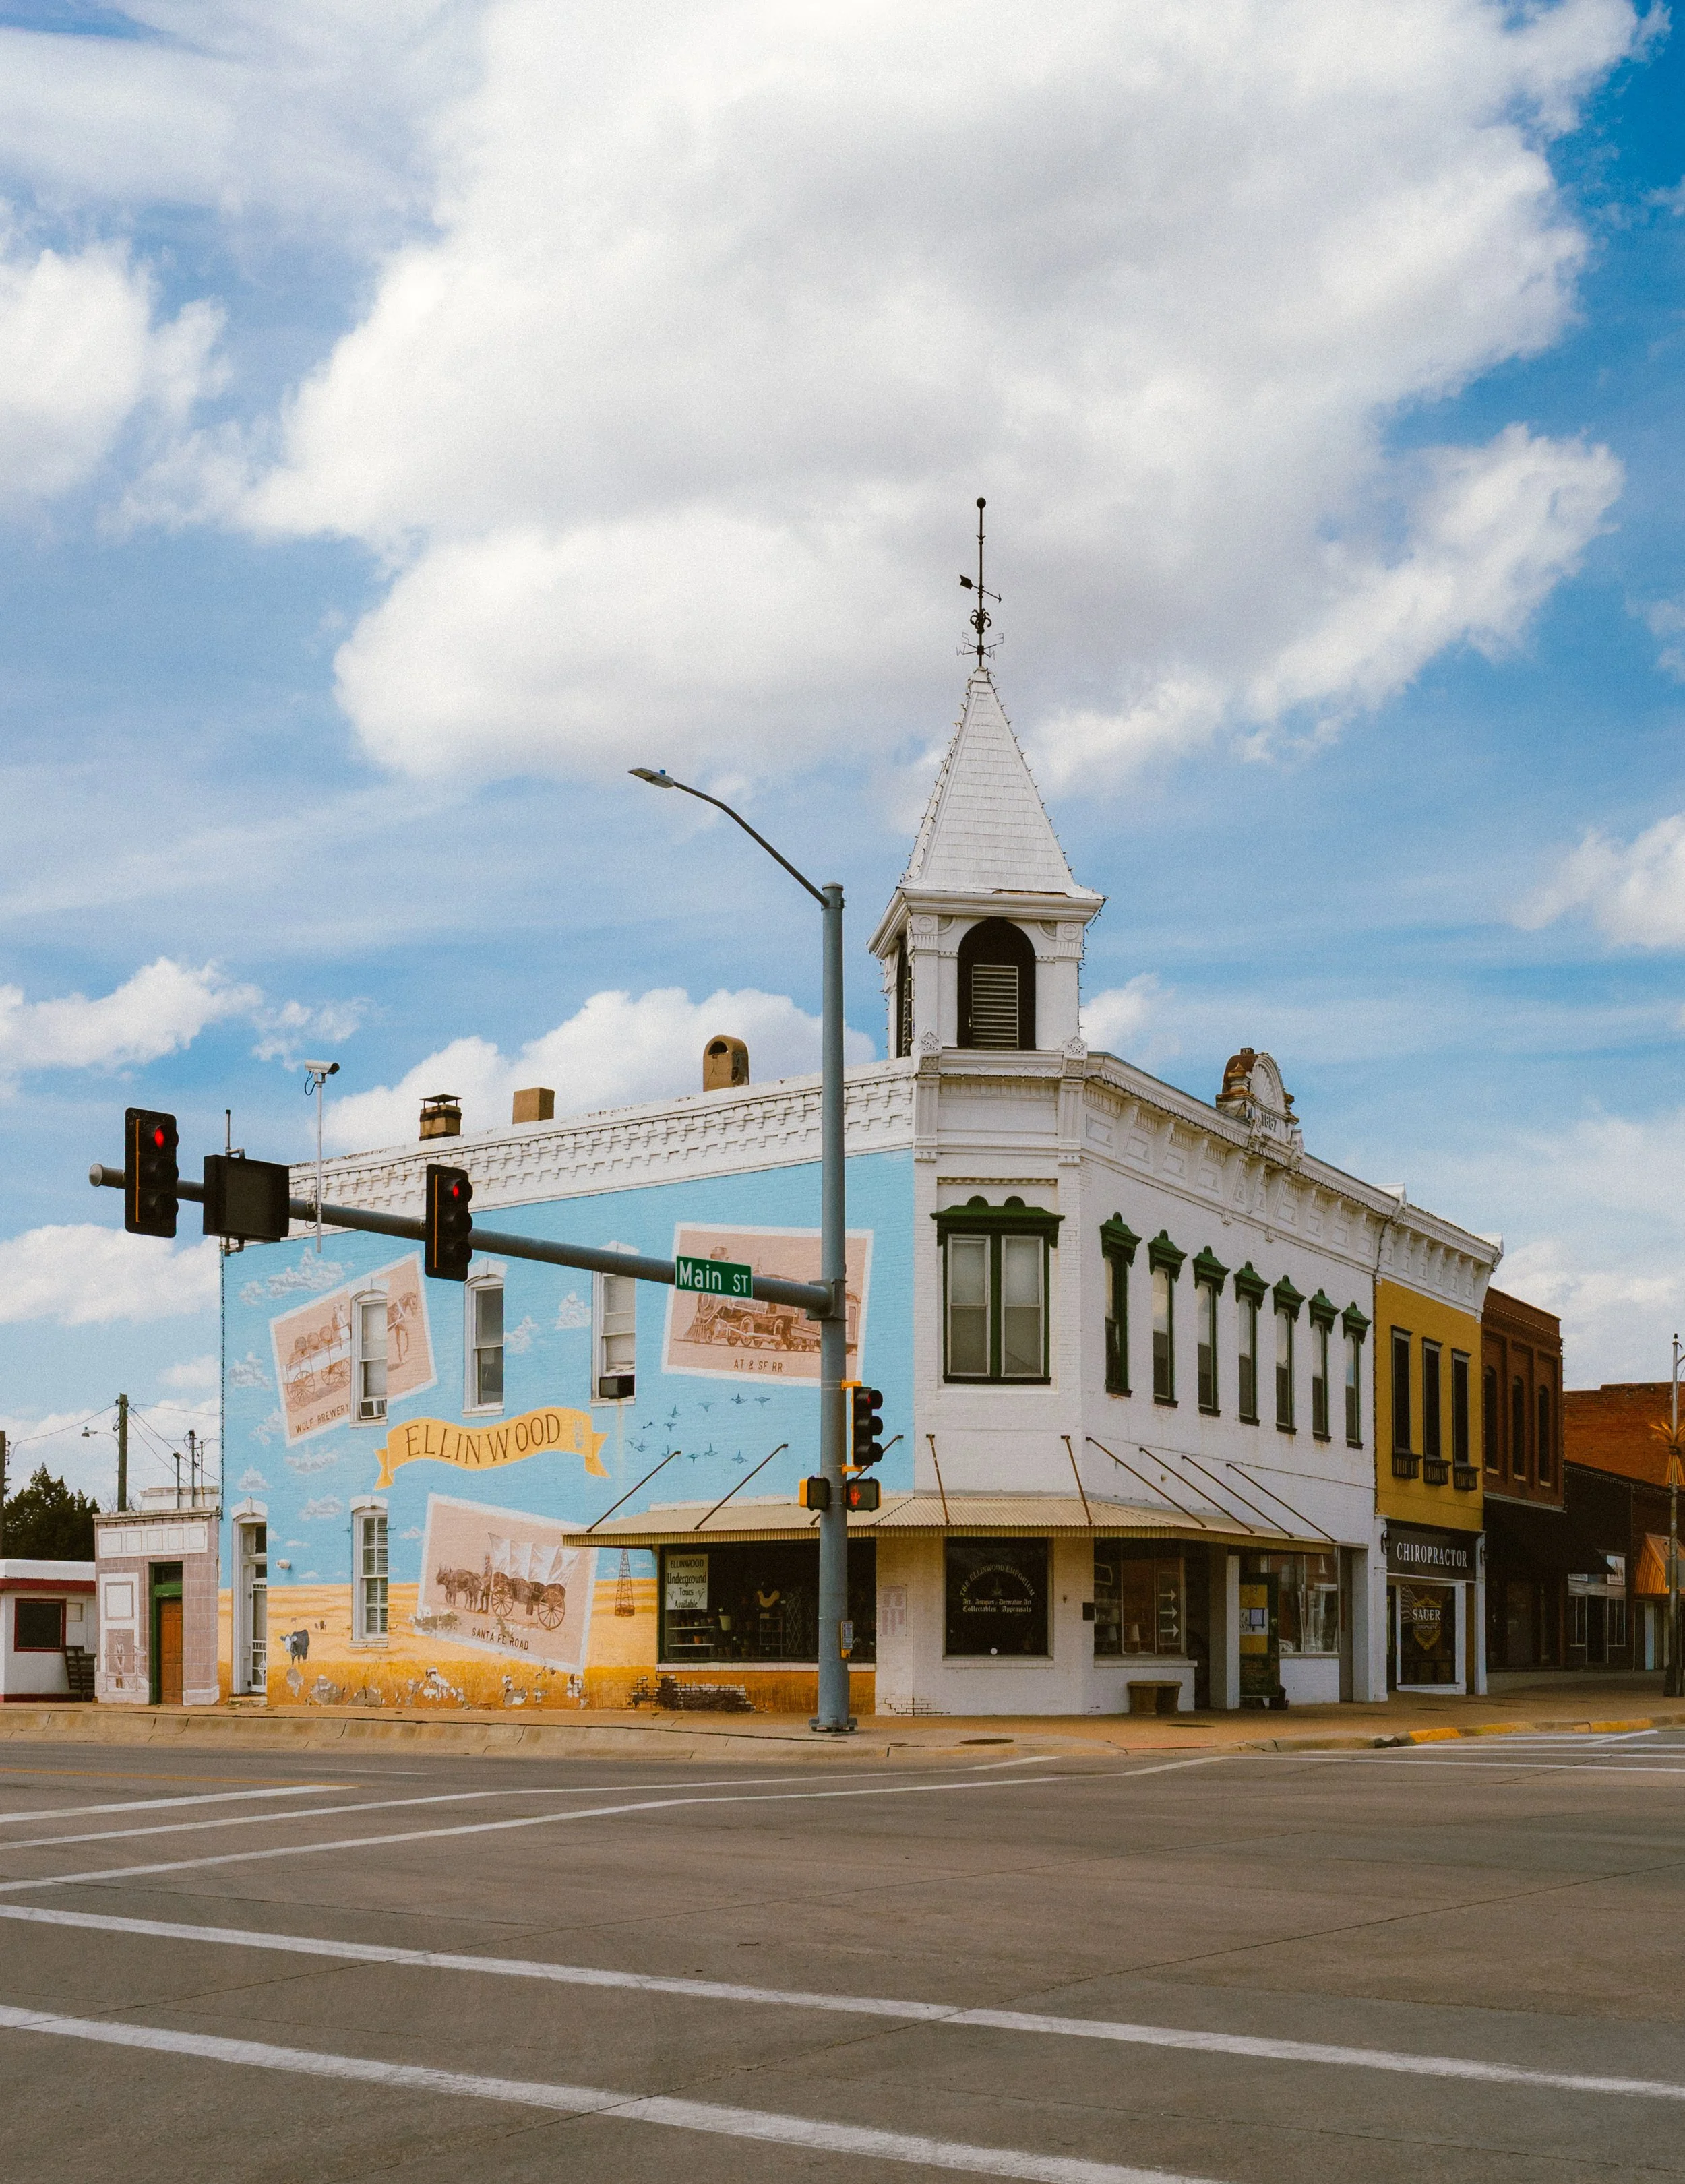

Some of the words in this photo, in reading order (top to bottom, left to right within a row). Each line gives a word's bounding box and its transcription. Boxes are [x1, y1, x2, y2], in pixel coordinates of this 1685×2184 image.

[679, 1260, 722, 1290] Main
[733, 1274, 748, 1293] ST
[733, 1359, 744, 1369] AT
[758, 1361, 768, 1371] SF
[772, 1361, 783, 1372] RR
[295, 1418, 313, 1433] WOLF
[317, 1403, 350, 1424] BREWERY
[405, 1414, 561, 1464] ELLINWOOD
[1397, 1542, 1467, 1567] CHIROPRACTOR
[671, 1559, 704, 1568] ELLINWOOD
[667, 1571, 707, 1587] Underground
[960, 1580, 971, 1596] THE
[969, 1564, 1005, 1582] ELLINWOOD
[1006, 1565, 1035, 1596] EMPORIUM
[679, 1587, 694, 1596] Tours
[674, 1599, 698, 1609] Available
[1002, 1605, 1032, 1613] Appraisals
[1413, 1608, 1440, 1621] SAUER
[472, 1627, 495, 1642] SANTA
[497, 1634, 506, 1644] FE
[510, 1637, 529, 1650] ROAD
